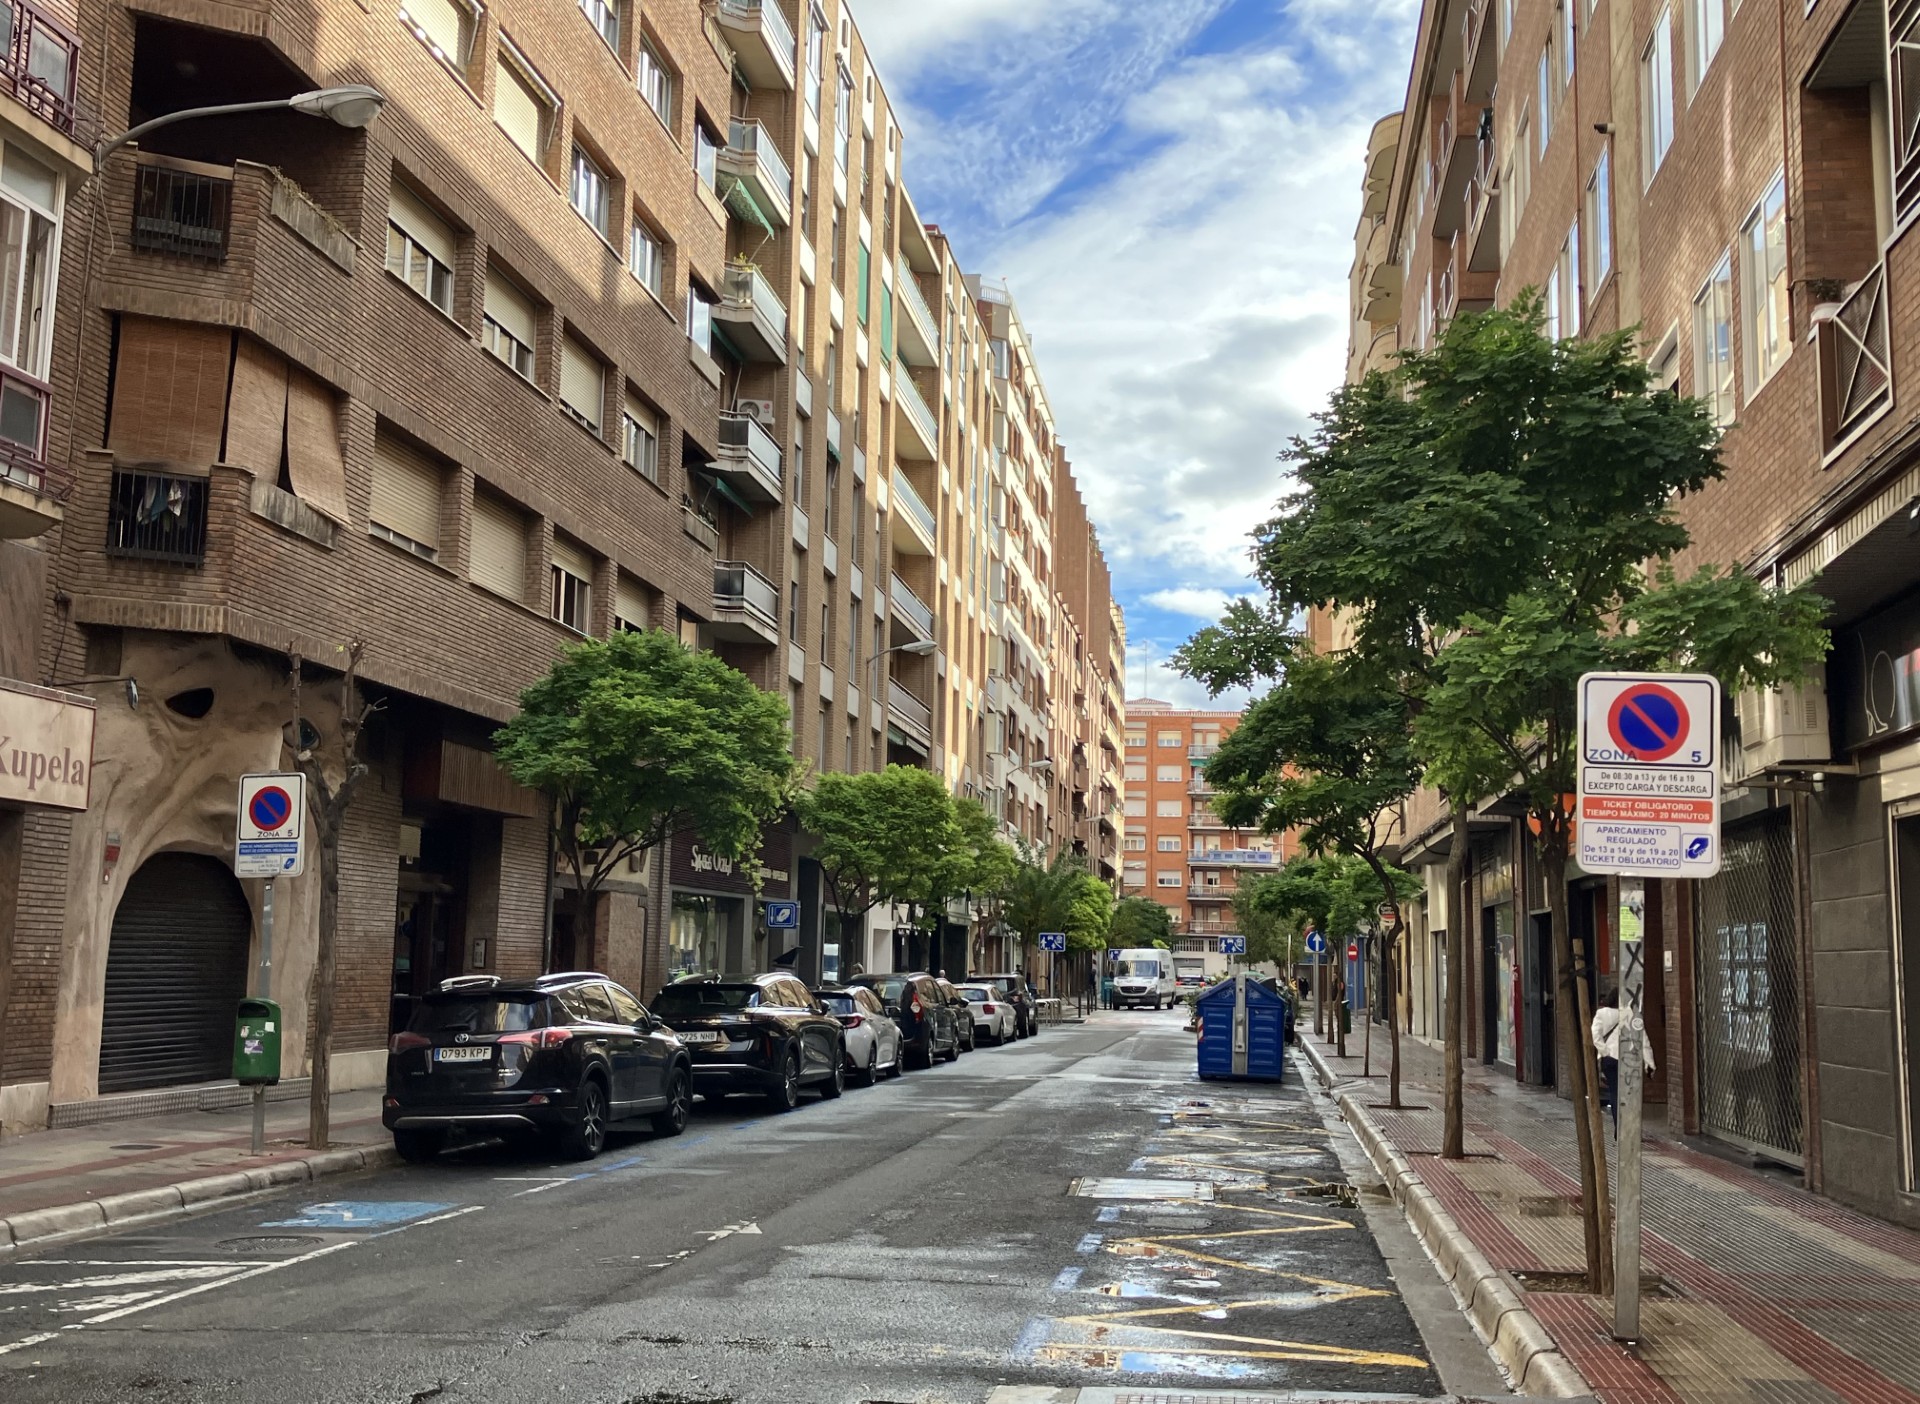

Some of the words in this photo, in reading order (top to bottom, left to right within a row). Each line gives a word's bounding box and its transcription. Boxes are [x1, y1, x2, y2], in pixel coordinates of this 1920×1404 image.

[1589, 749, 1637, 761] ZONA
[1691, 750, 1701, 763] 5
[1601, 772, 1610, 780] De
[1641, 773, 1649, 781] 13
[1658, 773, 1667, 781] de
[1669, 774, 1678, 782] 16
[1588, 781, 1625, 791] EXCEPTO
[1626, 783, 1655, 792] CARGA
[1656, 784, 1662, 792] Y
[1663, 784, 1707, 794] DESCARGA
[1602, 800, 1632, 809] TICKET
[1634, 801, 1693, 811] OBLIGATORIO
[1585, 808, 1618, 817] TIEMPO
[1659, 811, 1669, 819] 20
[1670, 812, 1710, 820] MINUTOS
[287, 829, 293, 837] 5
[1596, 826, 1667, 836] APARCAMIENTO
[1606, 836, 1656, 845] REGULADO
[1584, 845, 1595, 853] De
[1598, 845, 1607, 853] 13
[1636, 847, 1646, 855] de
[1649, 848, 1659, 856] 19
[1668, 848, 1679, 857] 20
[1584, 855, 1615, 863] TICKET
[1618, 856, 1679, 866] OBLIGATORIO
[441, 1048, 467, 1059] 0793
[469, 1047, 490, 1058] KPF
